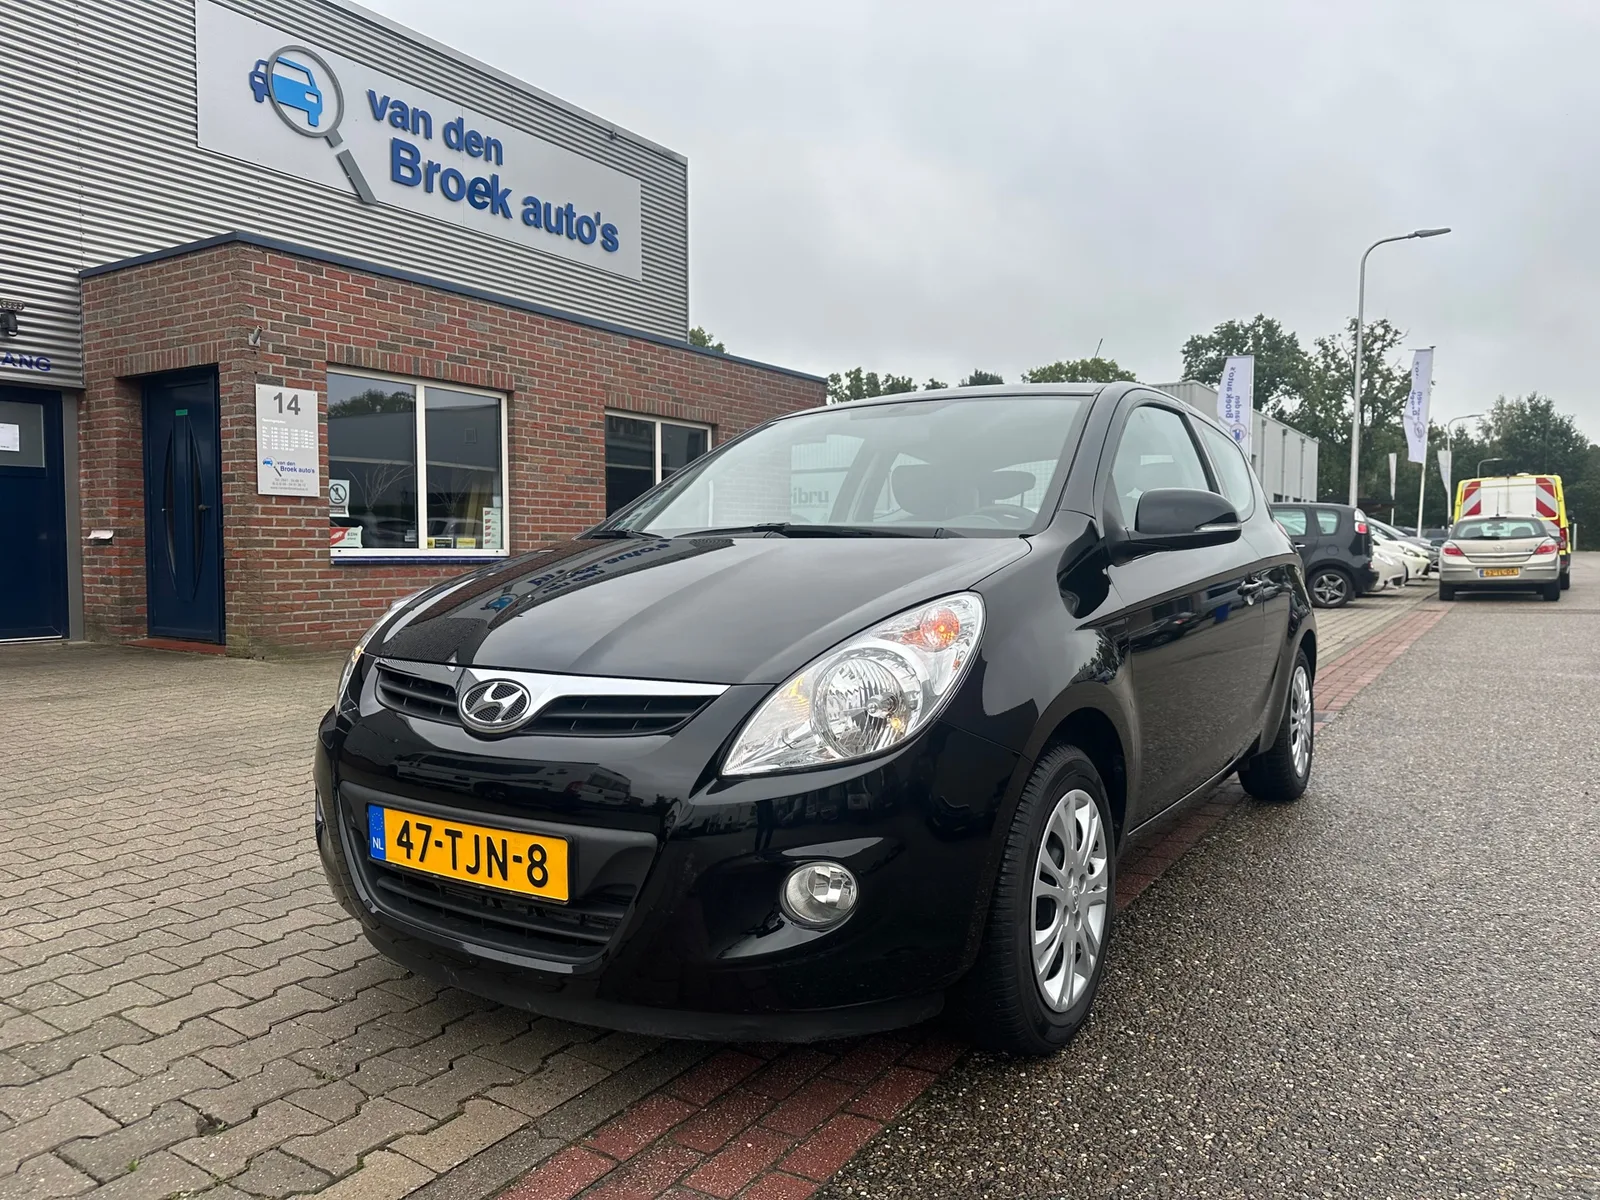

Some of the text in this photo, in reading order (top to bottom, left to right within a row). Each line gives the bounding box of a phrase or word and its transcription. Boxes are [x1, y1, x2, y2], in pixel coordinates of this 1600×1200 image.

[366, 89, 504, 165] van den
[390, 137, 620, 253] Broek auto's
[273, 392, 301, 416] 14
[372, 836, 384, 850] NL
[396, 819, 549, 888] 47-TJN-8
